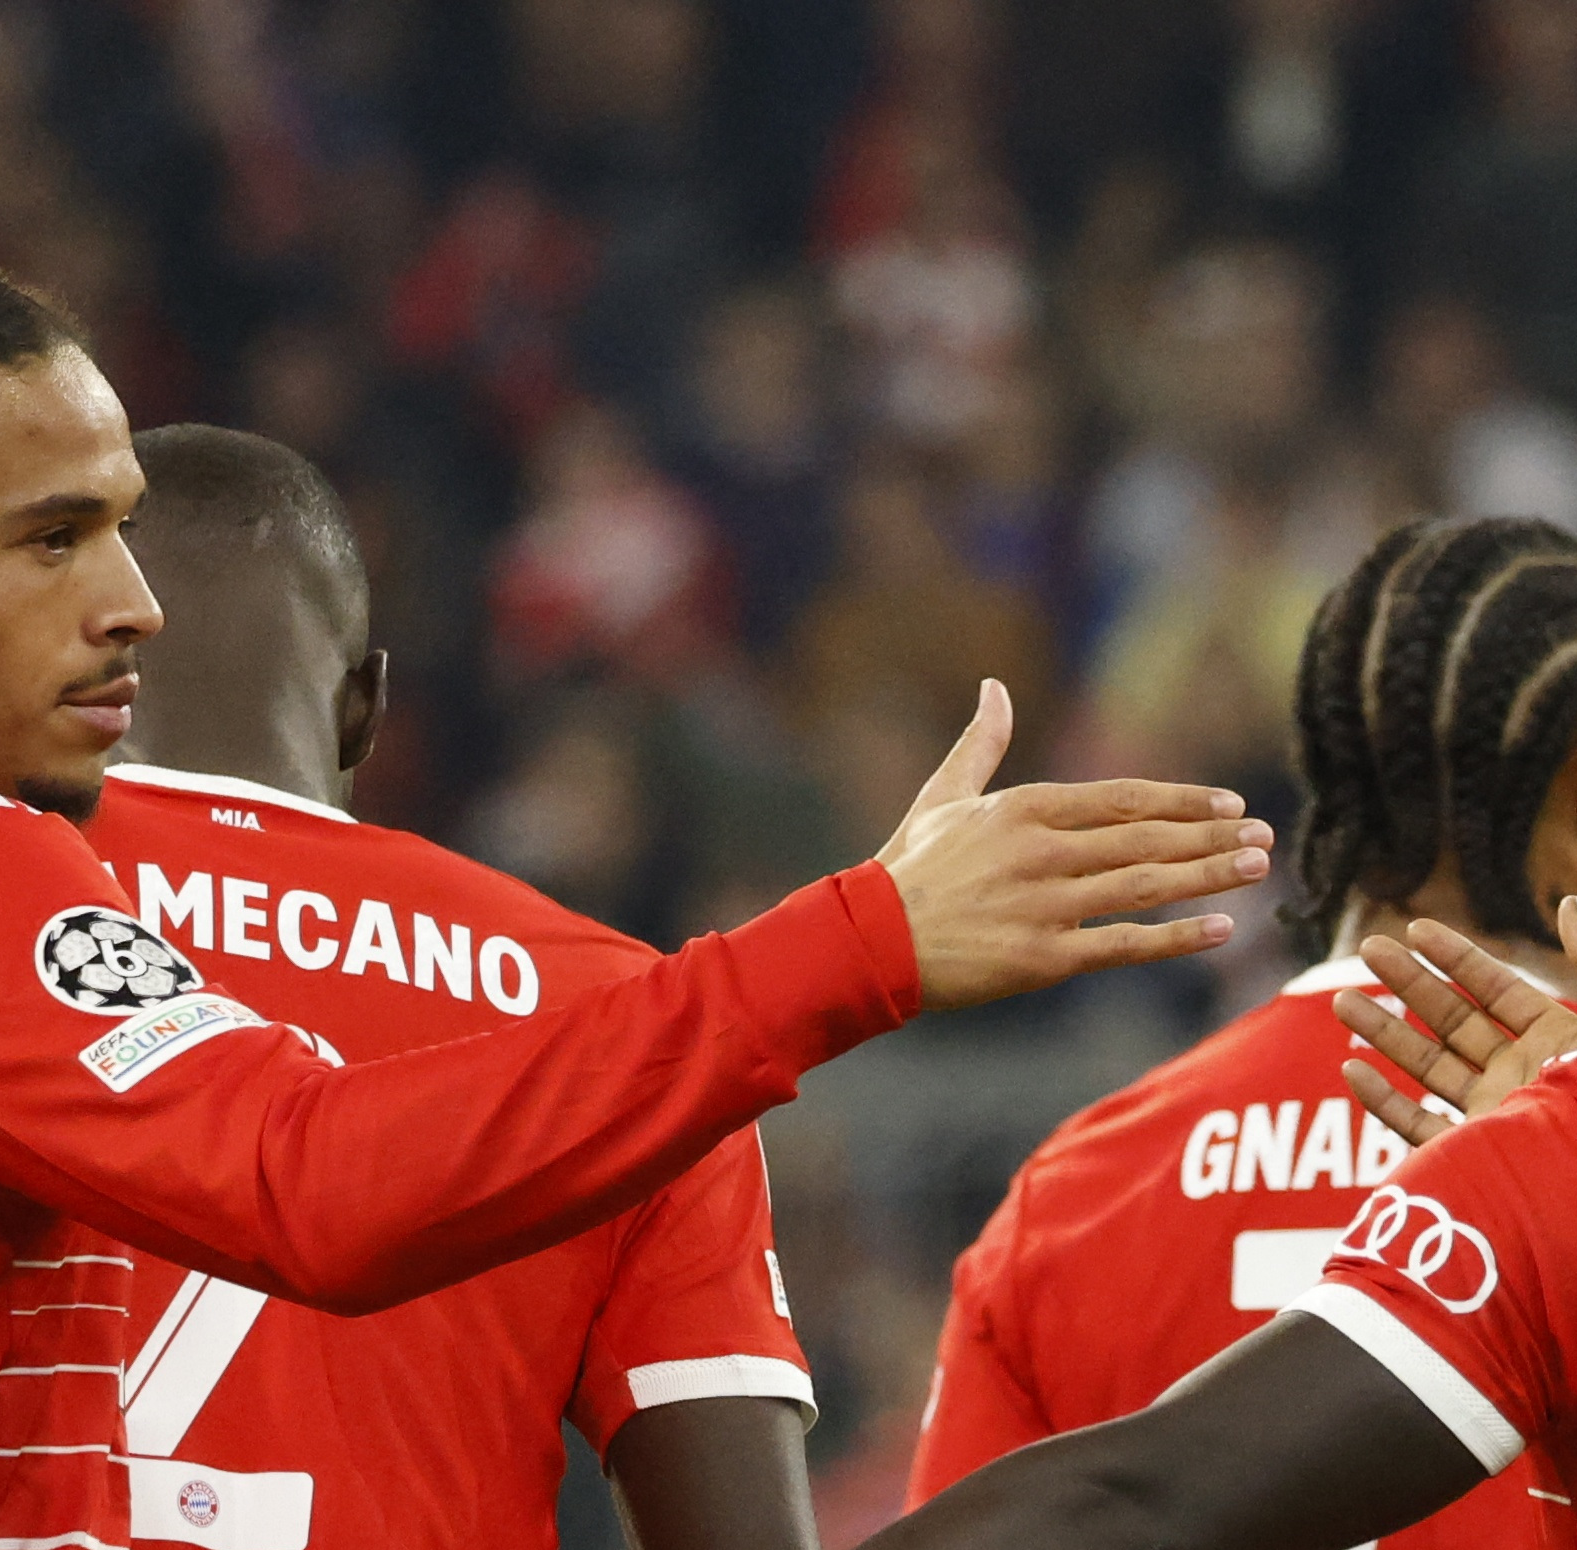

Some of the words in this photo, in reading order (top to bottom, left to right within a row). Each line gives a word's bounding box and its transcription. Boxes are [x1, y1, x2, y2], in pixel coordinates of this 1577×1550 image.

[210, 807, 265, 832] MIA
[101, 861, 540, 1017] MECANO
[88, 1031, 130, 1063] UEFA
